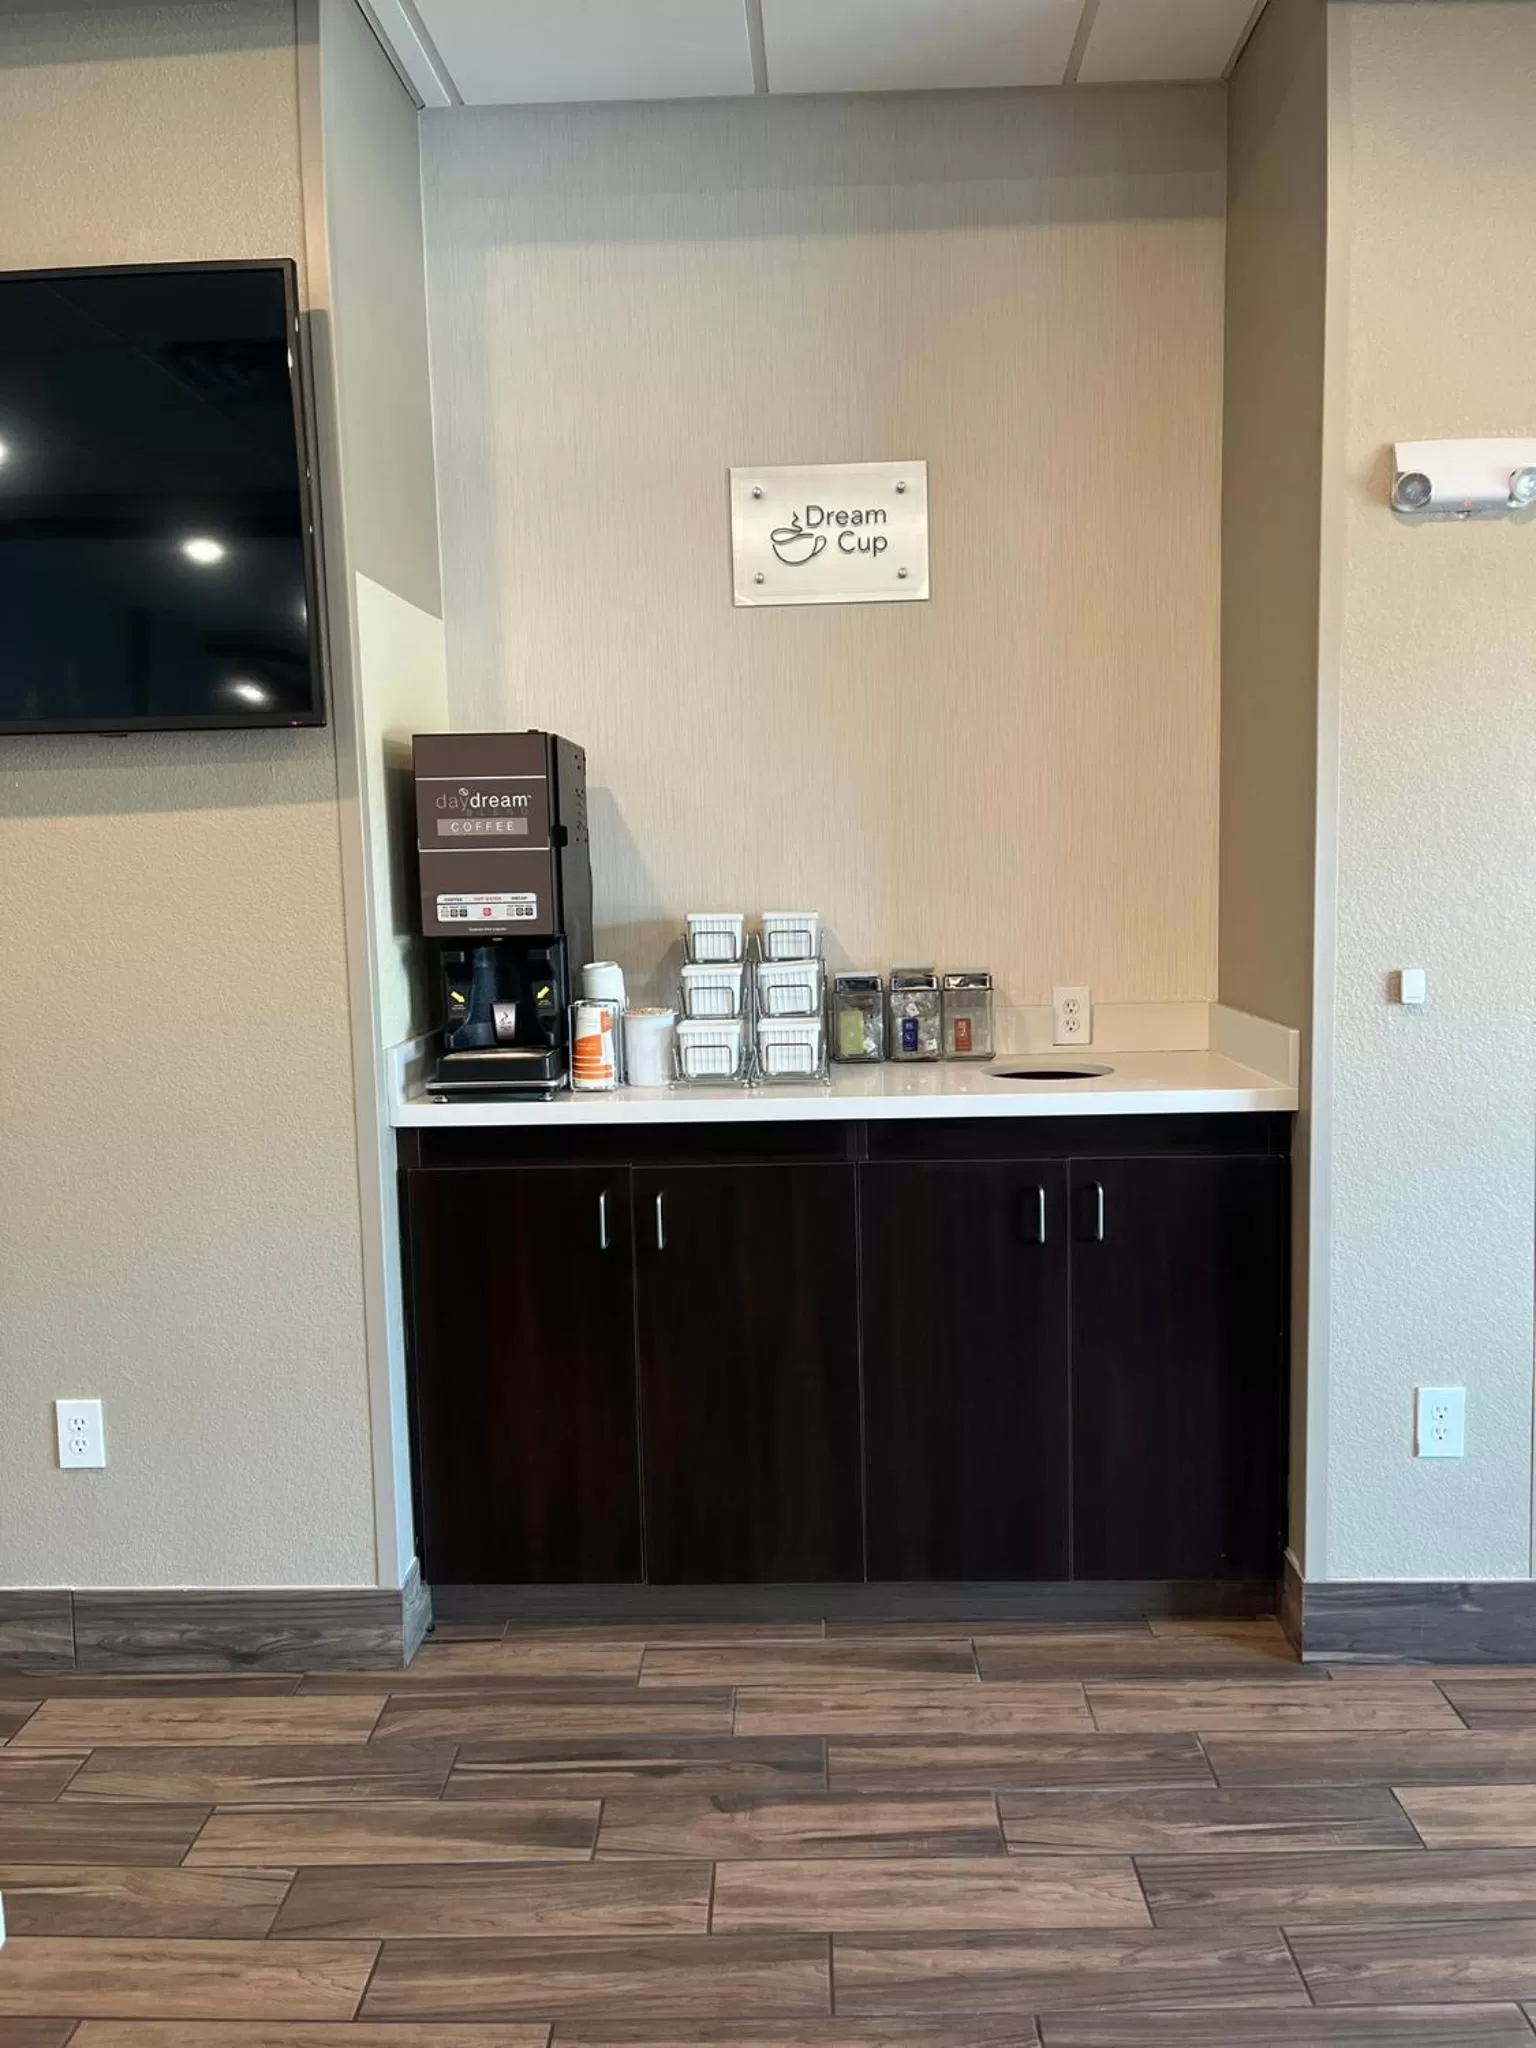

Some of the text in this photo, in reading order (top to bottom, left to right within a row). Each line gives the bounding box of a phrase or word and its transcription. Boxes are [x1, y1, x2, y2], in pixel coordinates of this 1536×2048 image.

[805, 505, 888, 528] Dream
[837, 530, 889, 557] Cup
[436, 792, 529, 811] daydream
[450, 821, 514, 832] COFFEE
